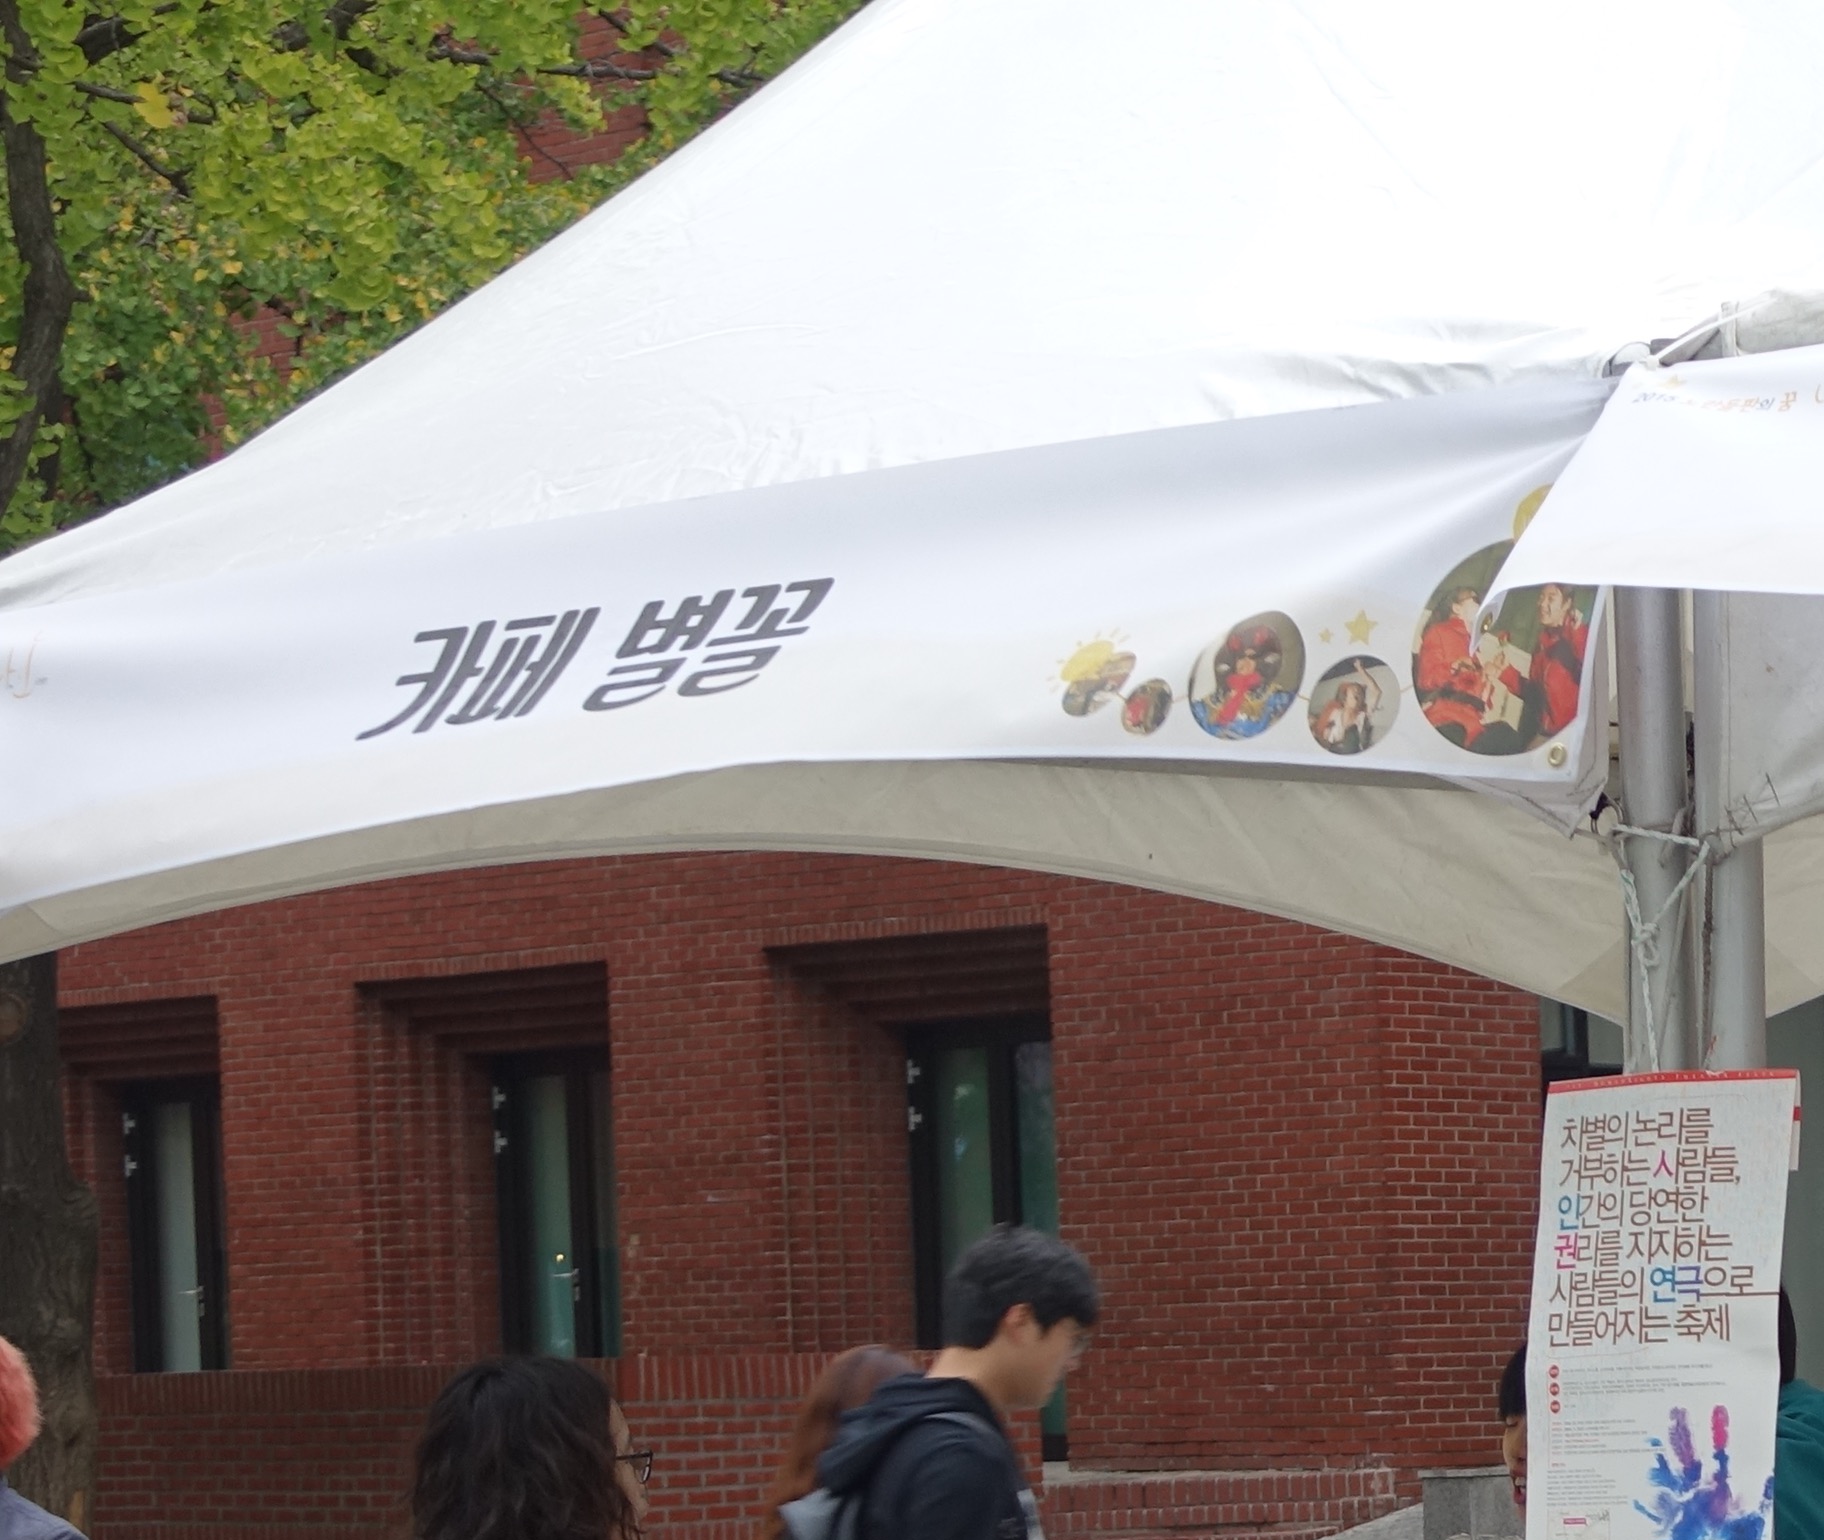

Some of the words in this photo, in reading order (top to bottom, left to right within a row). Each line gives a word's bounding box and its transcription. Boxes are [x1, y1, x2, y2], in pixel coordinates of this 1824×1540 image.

[355, 606, 601, 742] 카페
[582, 577, 835, 712] 별꼴
[1561, 1111, 1629, 1153] 차별의
[1632, 1107, 1714, 1148] 논리를
[1559, 1150, 1650, 1191] 거부하는
[1653, 1146, 1740, 1185] 사람들,
[1558, 1189, 1624, 1230] 인간의
[1629, 1185, 1709, 1226] 당연한
[1554, 1229, 1623, 1269] 권리를
[1626, 1225, 1733, 1264] 지지하는
[1550, 1267, 1644, 1308] 사람들의
[1650, 1265, 1775, 1303] 연극으로
[1548, 1305, 1671, 1348] 만들어지는
[1674, 1303, 1730, 1342] 축제
